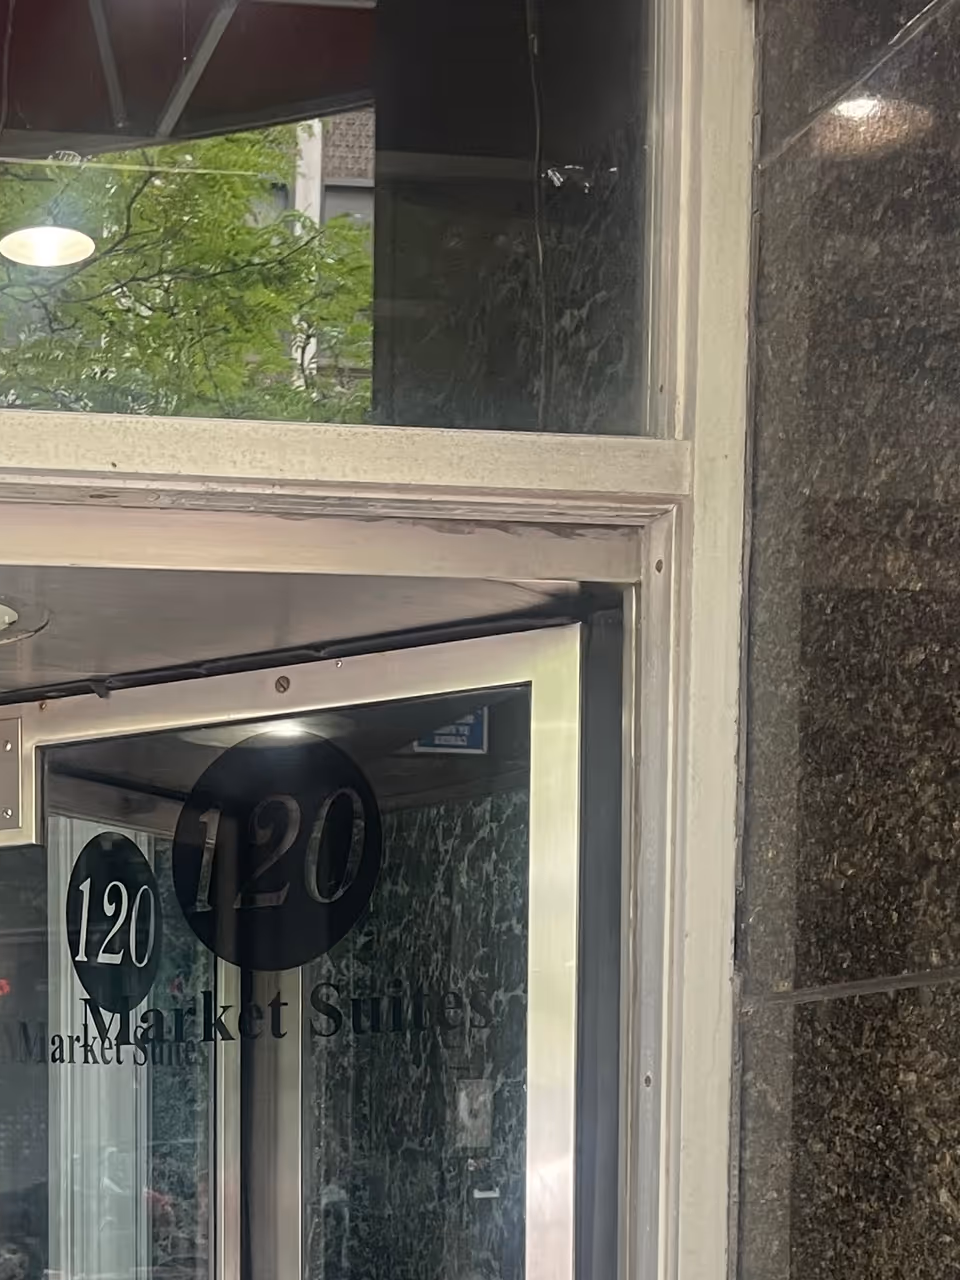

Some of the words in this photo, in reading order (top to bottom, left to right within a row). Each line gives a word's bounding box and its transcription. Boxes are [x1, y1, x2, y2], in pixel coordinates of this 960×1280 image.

[195, 788, 366, 912] 120
[74, 877, 155, 968] 120
[12, 1022, 124, 1067] Market
[79, 991, 288, 1048] Market
[310, 976, 494, 1040] Suites
